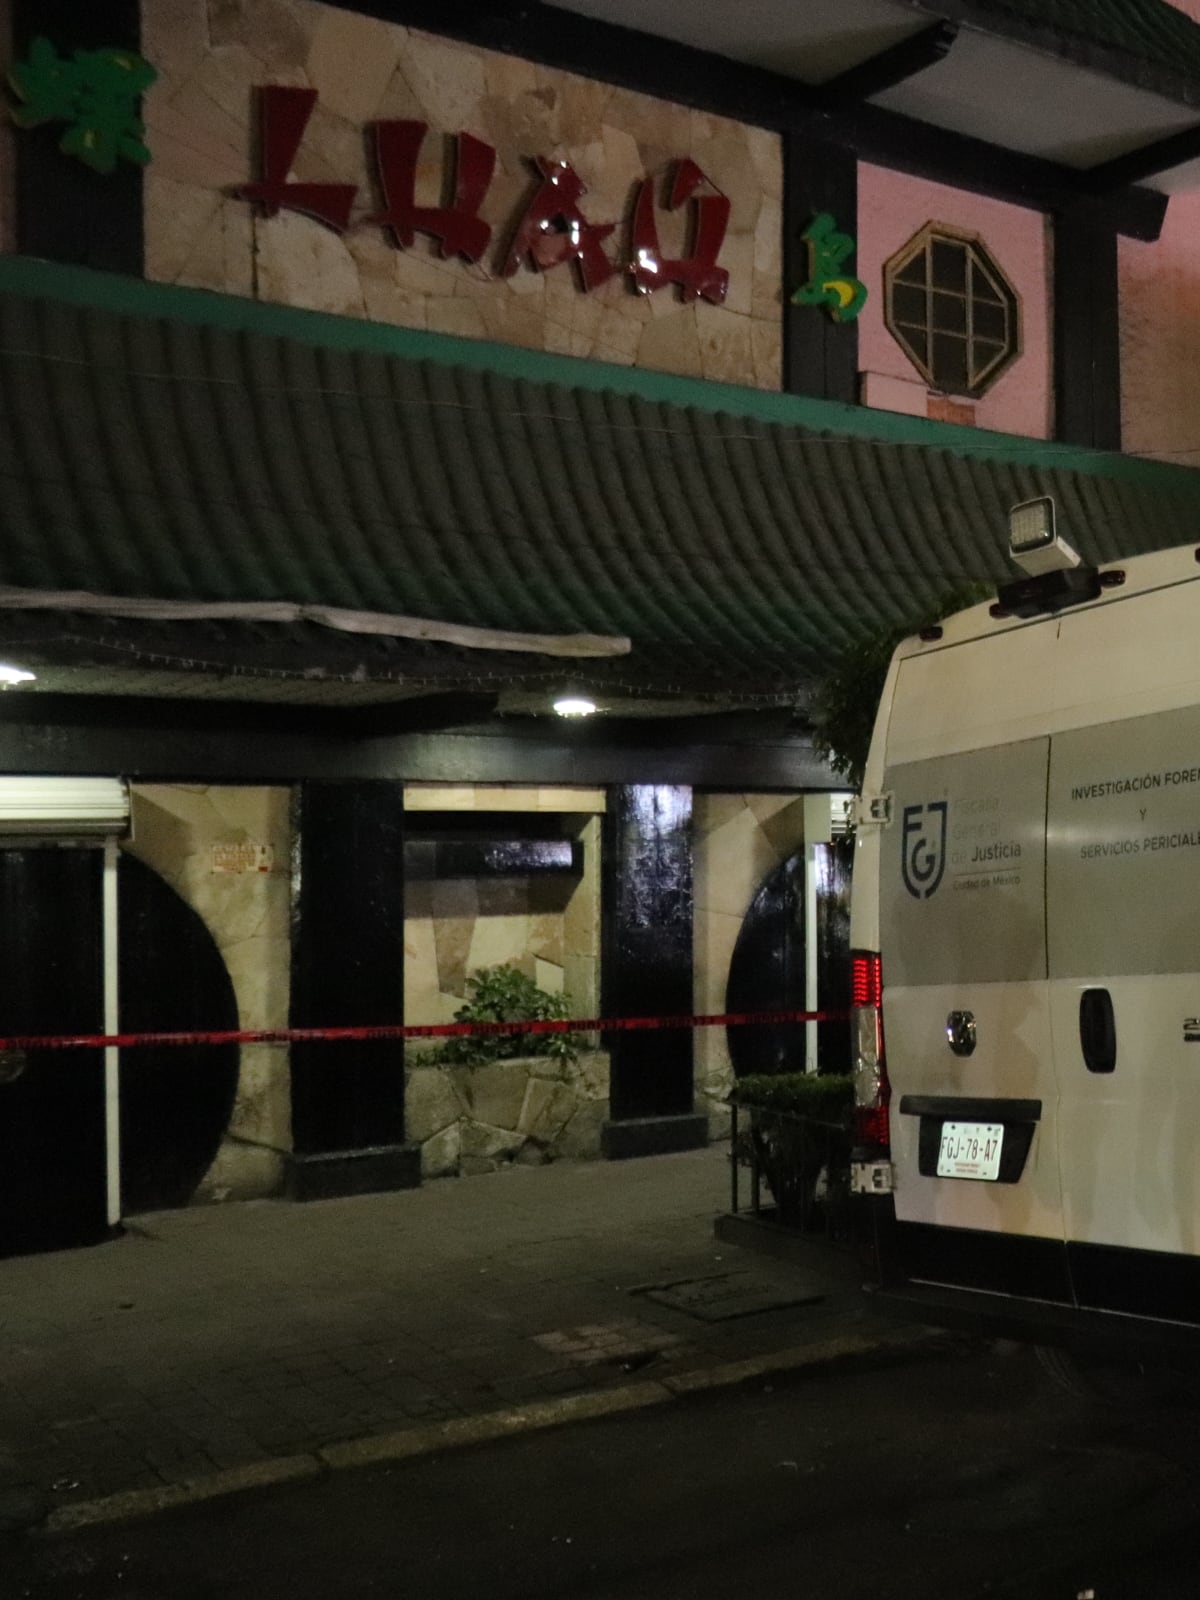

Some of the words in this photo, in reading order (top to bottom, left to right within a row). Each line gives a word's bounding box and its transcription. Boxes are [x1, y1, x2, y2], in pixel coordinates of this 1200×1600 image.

[1071, 772, 1161, 801] INVESTIGACIÓN
[1139, 808, 1147, 821] Y
[971, 840, 1022, 862] Justicia
[1080, 839, 1141, 859] SERVICIOS
[940, 1136, 999, 1162] FGJ-78-A7
